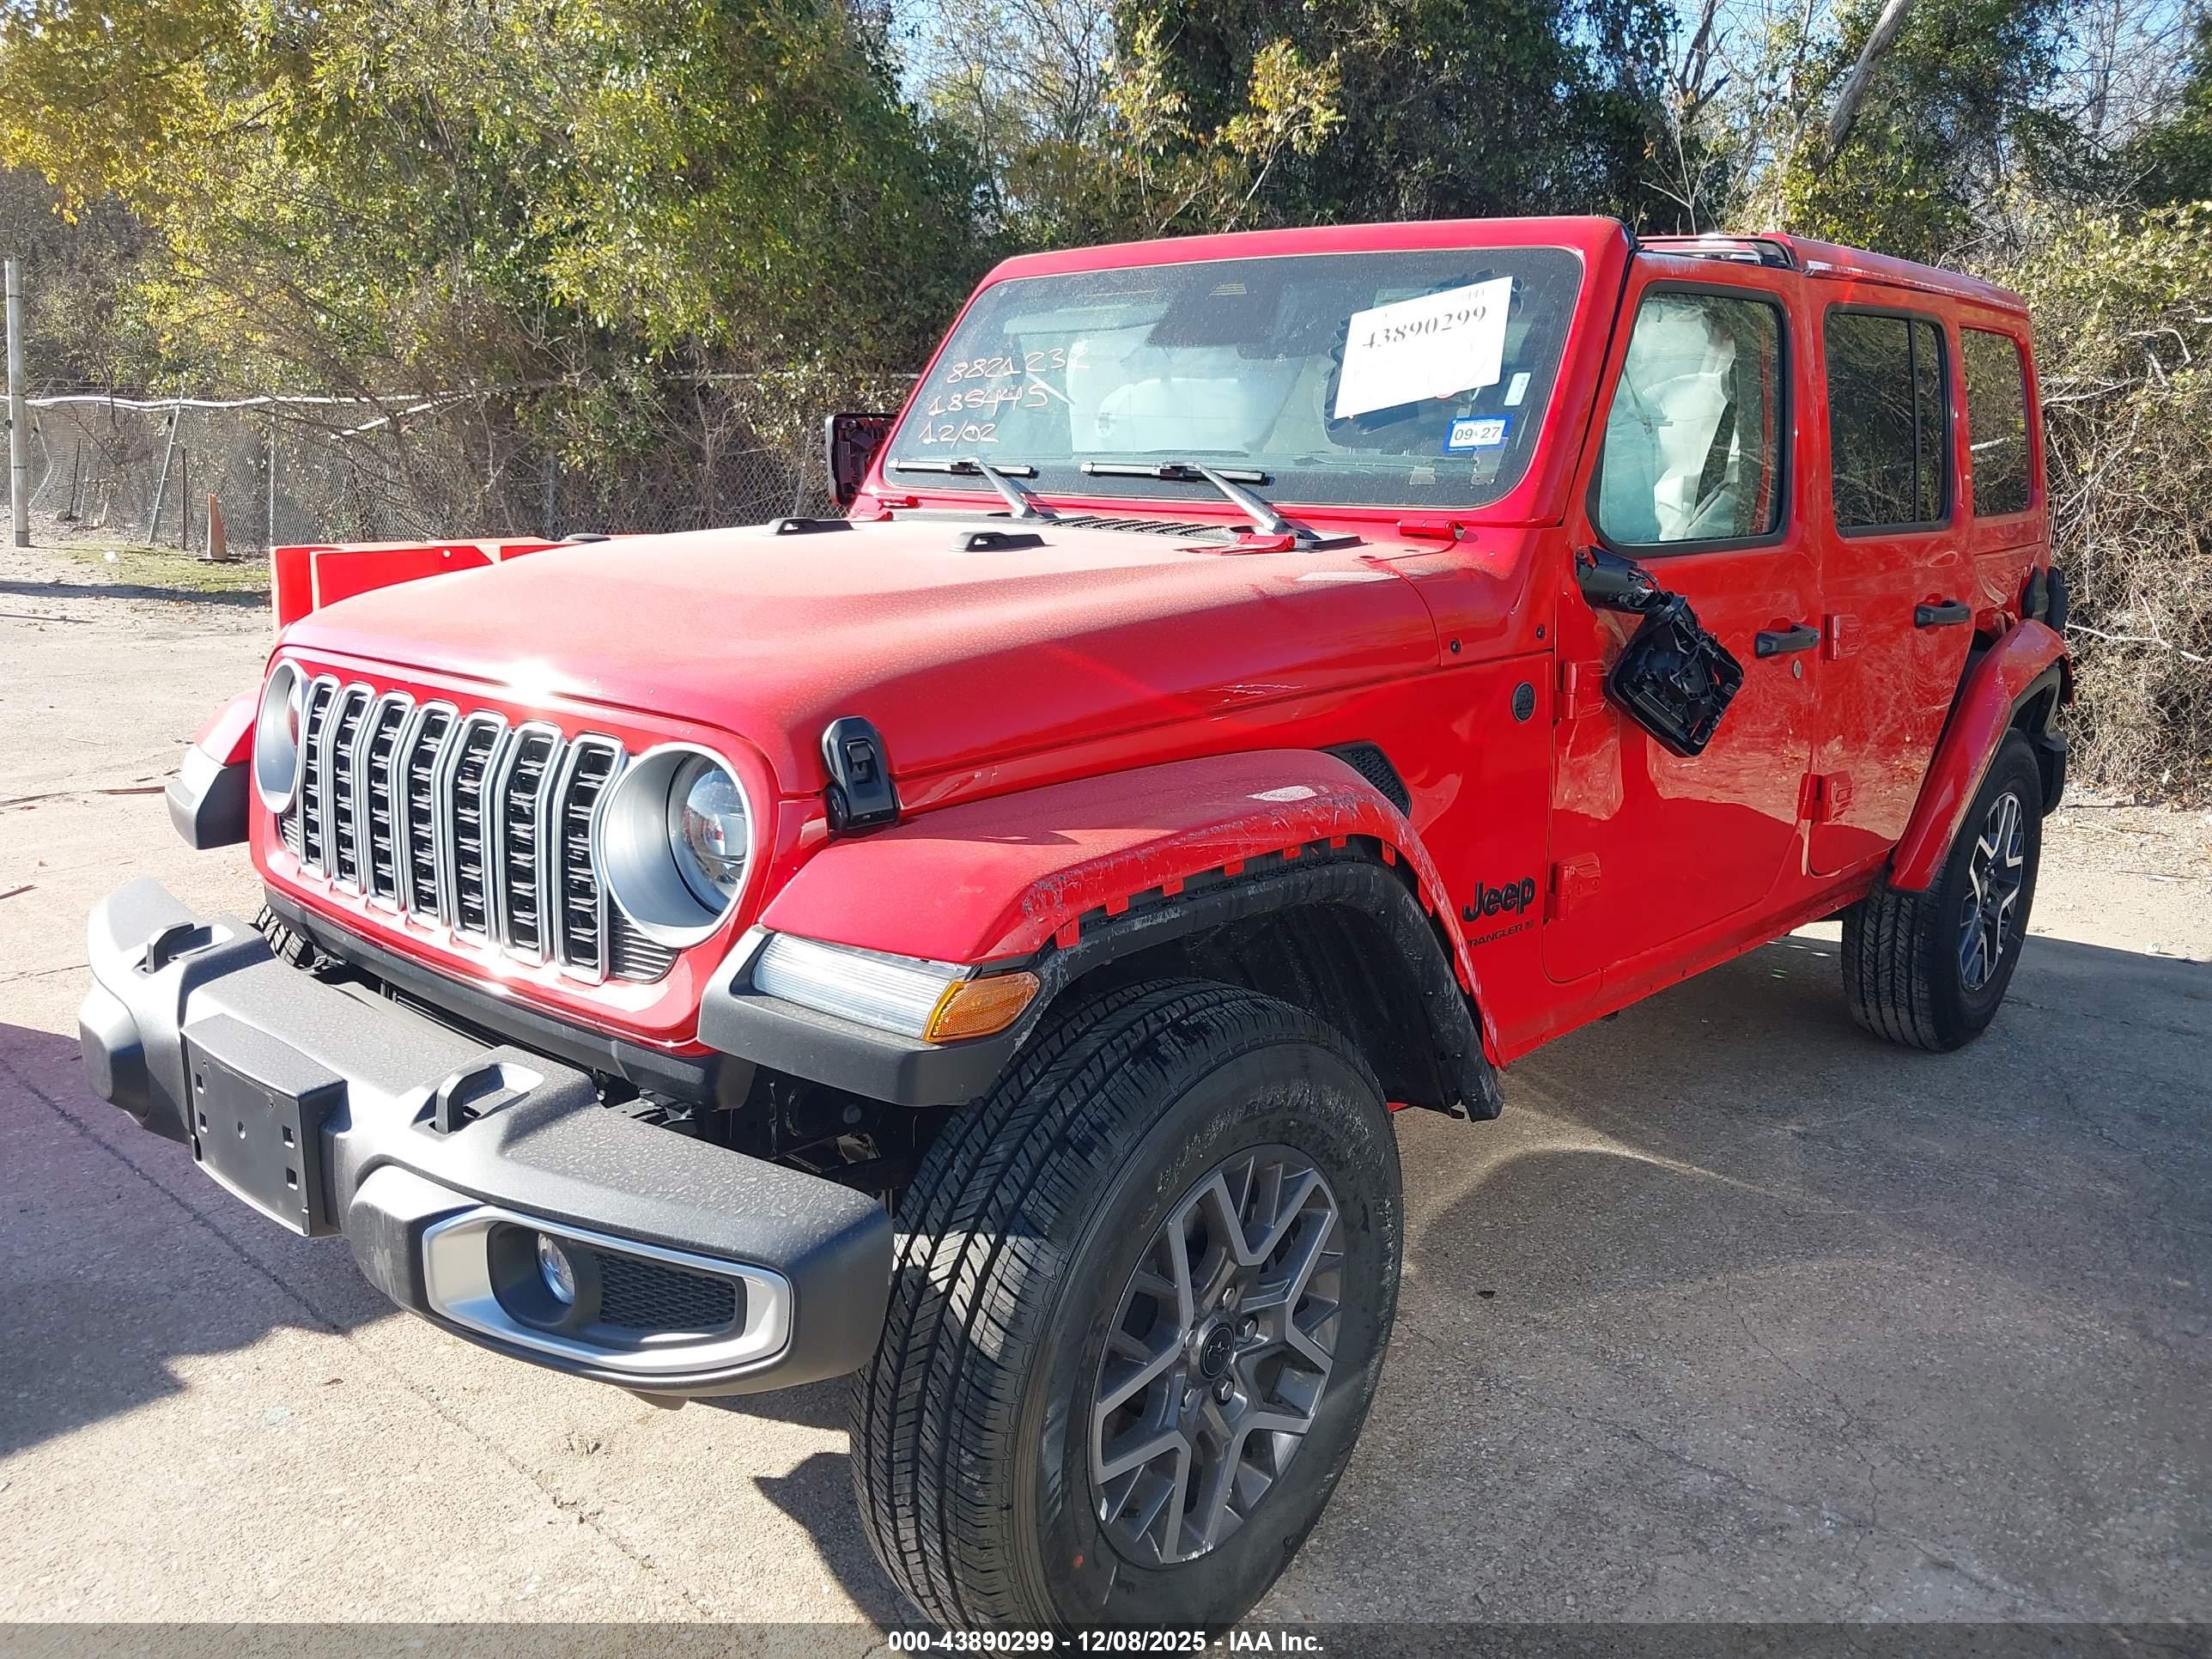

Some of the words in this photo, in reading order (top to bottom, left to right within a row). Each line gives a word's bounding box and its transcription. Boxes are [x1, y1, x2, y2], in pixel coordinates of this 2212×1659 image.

[1362, 306, 1486, 349] 43890299
[918, 420, 1000, 451] 12/02
[1462, 877, 1535, 922] Jeep
